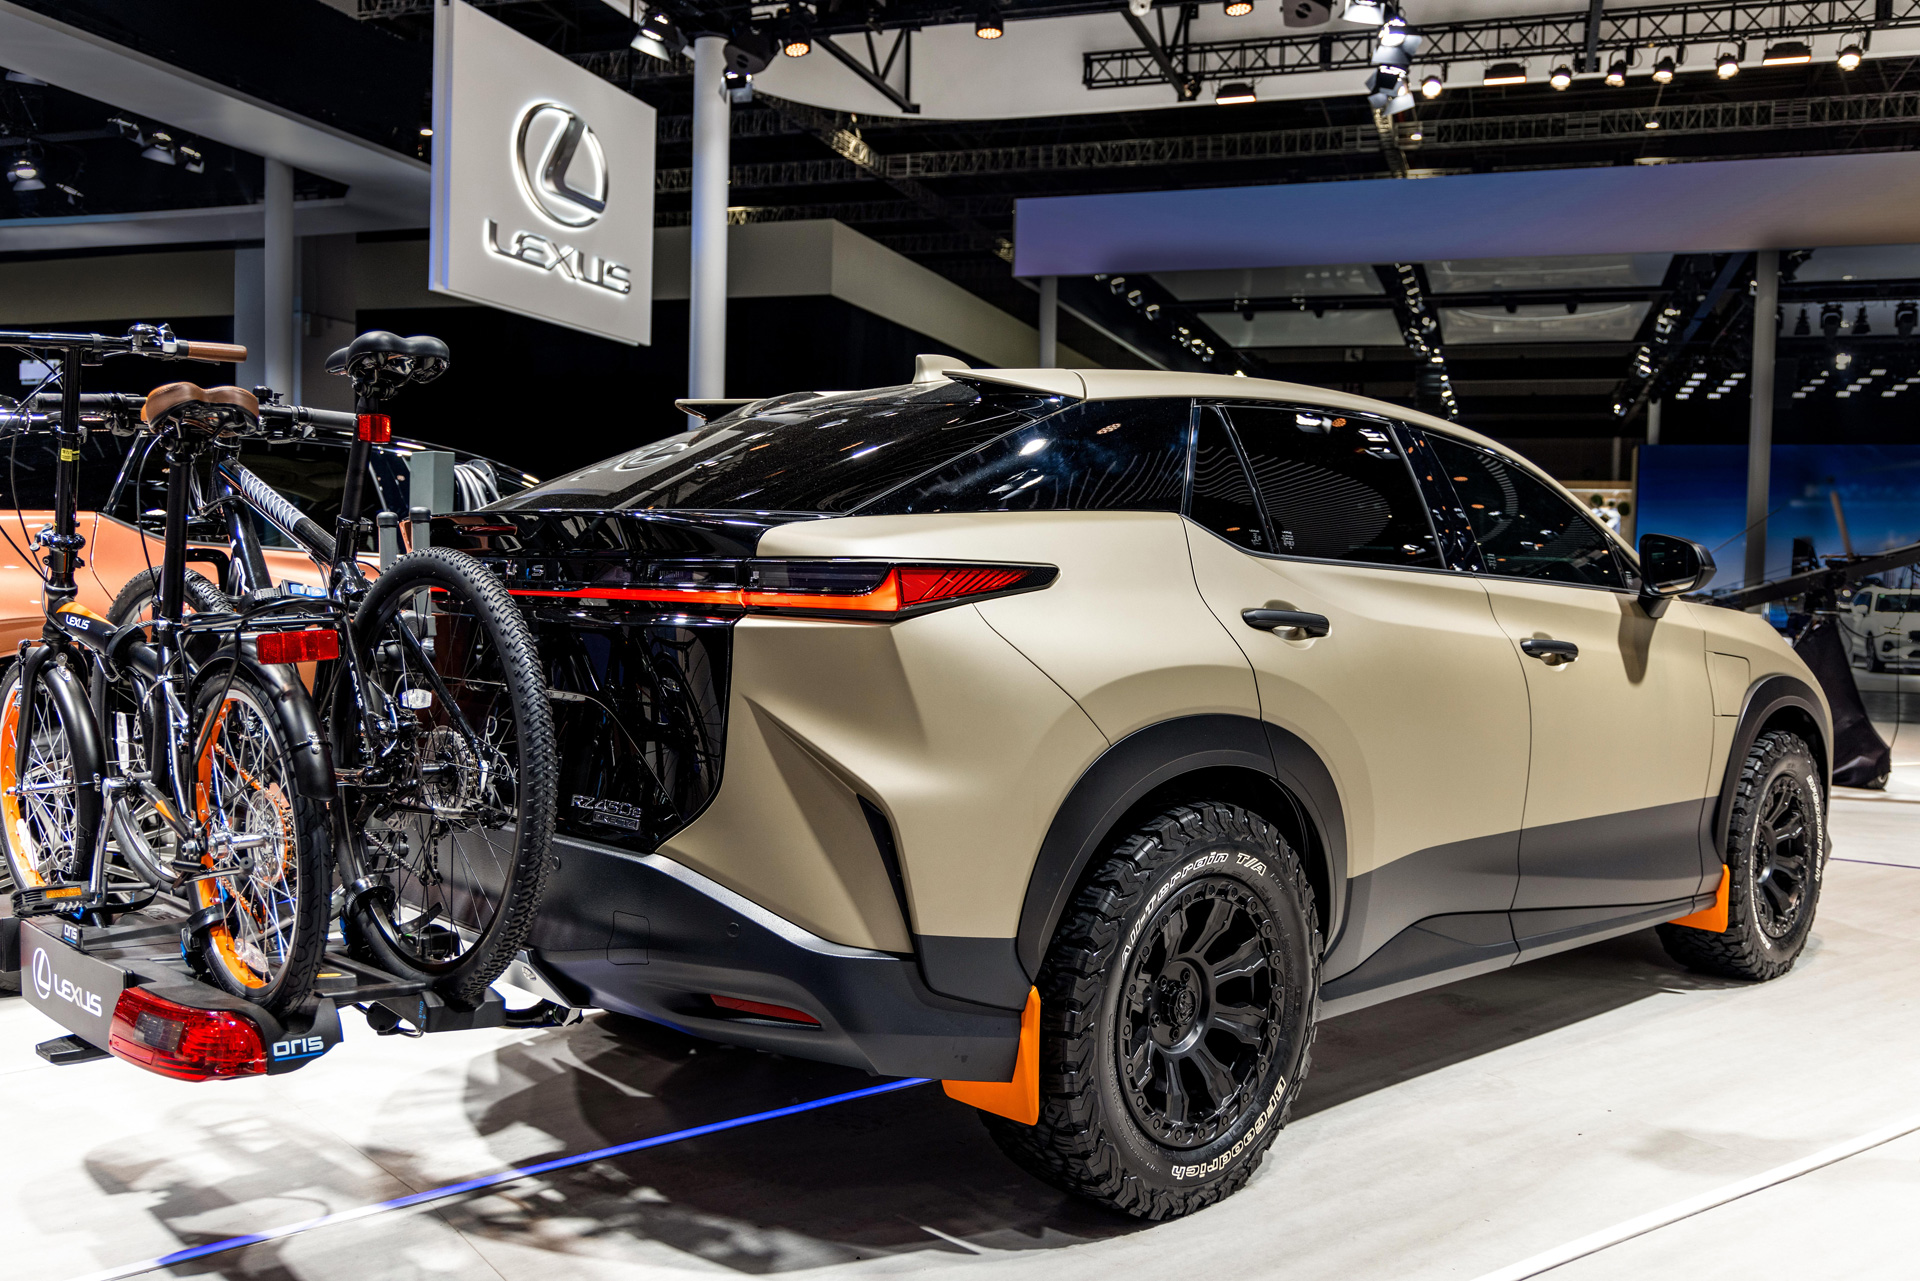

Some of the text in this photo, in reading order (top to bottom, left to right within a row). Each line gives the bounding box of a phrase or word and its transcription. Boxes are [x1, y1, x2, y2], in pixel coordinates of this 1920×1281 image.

[485, 217, 631, 296] LEXUS
[65, 614, 90, 630] LEXUS
[1121, 851, 1268, 971] All-Terrain T/A
[54, 973, 102, 1017] LEXUS
[1171, 1075, 1287, 1180] BFGoodrich
